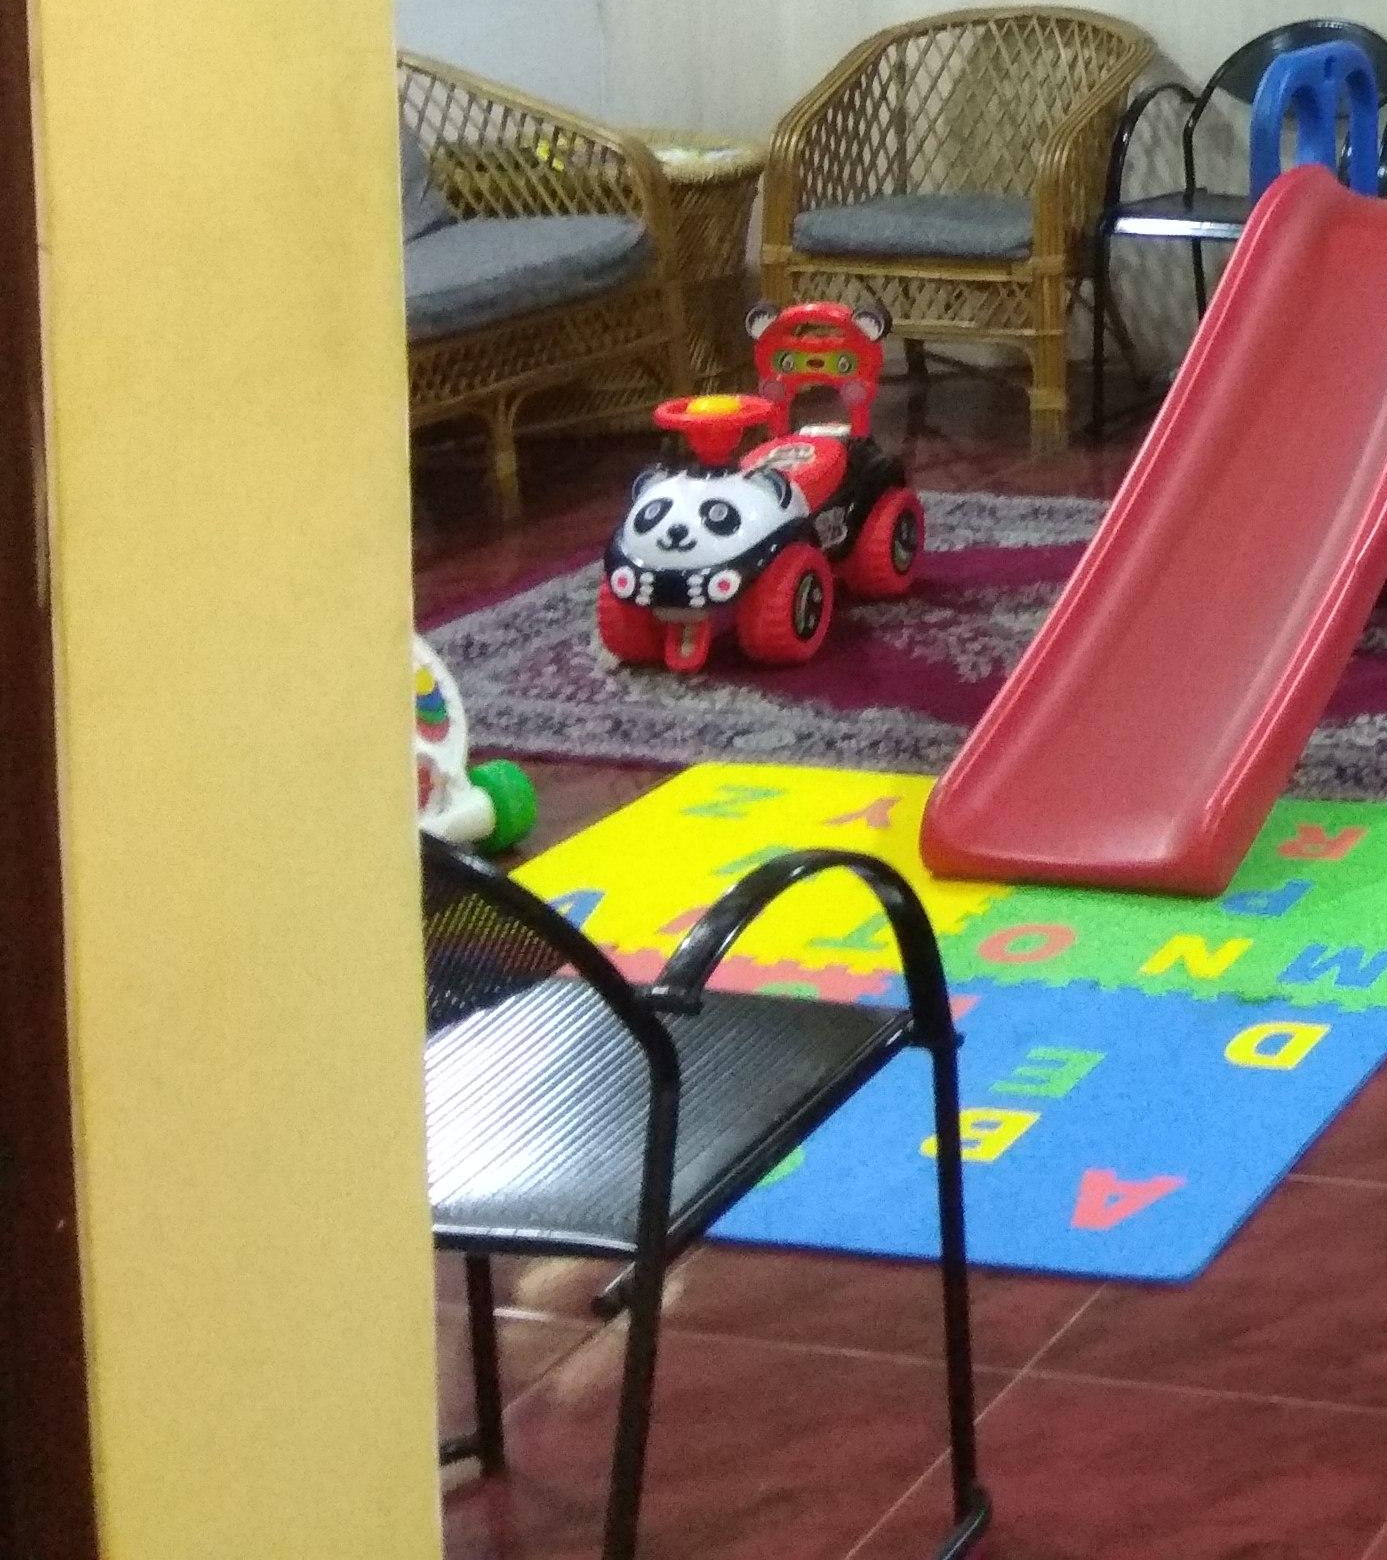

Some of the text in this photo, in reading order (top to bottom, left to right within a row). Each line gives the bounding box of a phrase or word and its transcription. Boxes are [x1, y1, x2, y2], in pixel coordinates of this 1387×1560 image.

[1278, 825, 1367, 861] R
[1221, 880, 1313, 916] P
[978, 924, 1076, 963] O
[1139, 935, 1253, 977] N
[1224, 1022, 1332, 1069] D
[990, 1048, 1105, 1097] E
[1071, 1169, 1185, 1229] A
